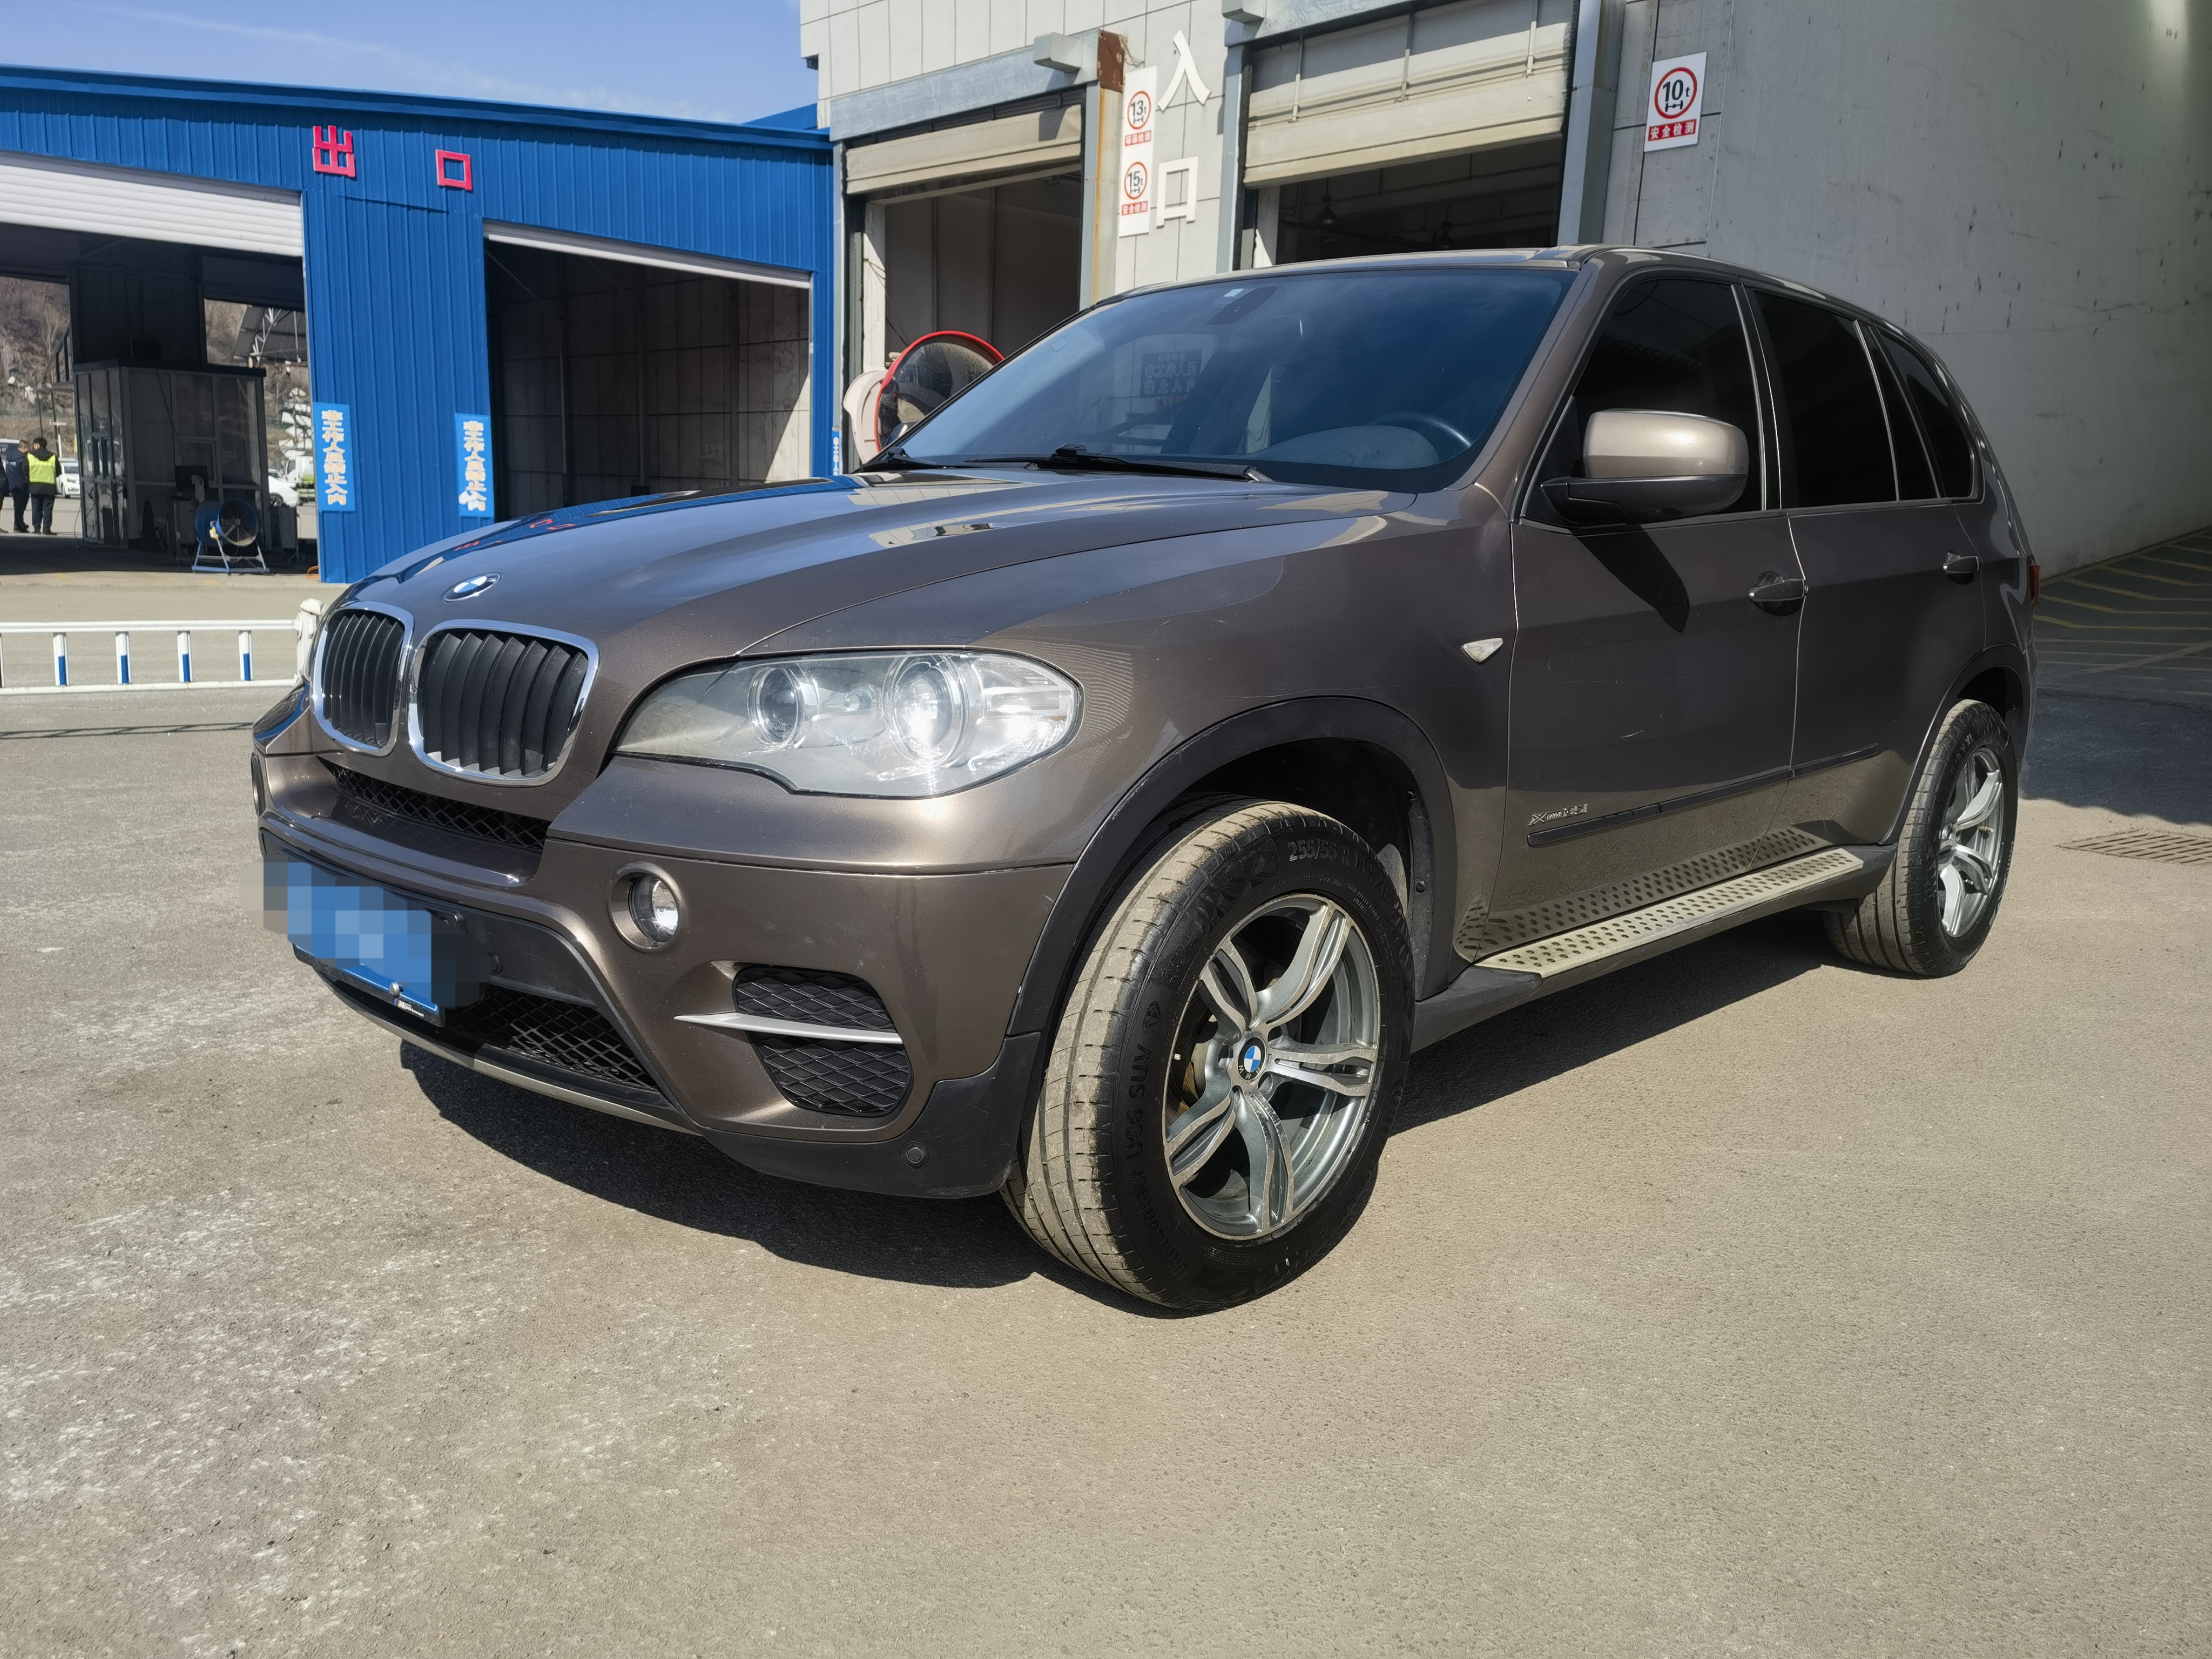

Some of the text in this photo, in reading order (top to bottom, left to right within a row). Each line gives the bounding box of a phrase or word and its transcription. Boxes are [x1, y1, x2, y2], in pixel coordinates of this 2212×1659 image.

[1125, 130, 1151, 146] 环保检测
[1156, 30, 1212, 228] 入口
[1650, 120, 1695, 140] 安全检测
[312, 125, 473, 191] 出口
[1122, 201, 1148, 215] 安全检测
[321, 409, 348, 506] 非工作人员禁止入内
[463, 421, 487, 511] 非工作人员禁止入内
[1287, 839, 1337, 862] 255/55
[1128, 1043, 1152, 1100] SUV
[1238, 1064, 1260, 1079] BMW
[1125, 1108, 1145, 1161] UC6
